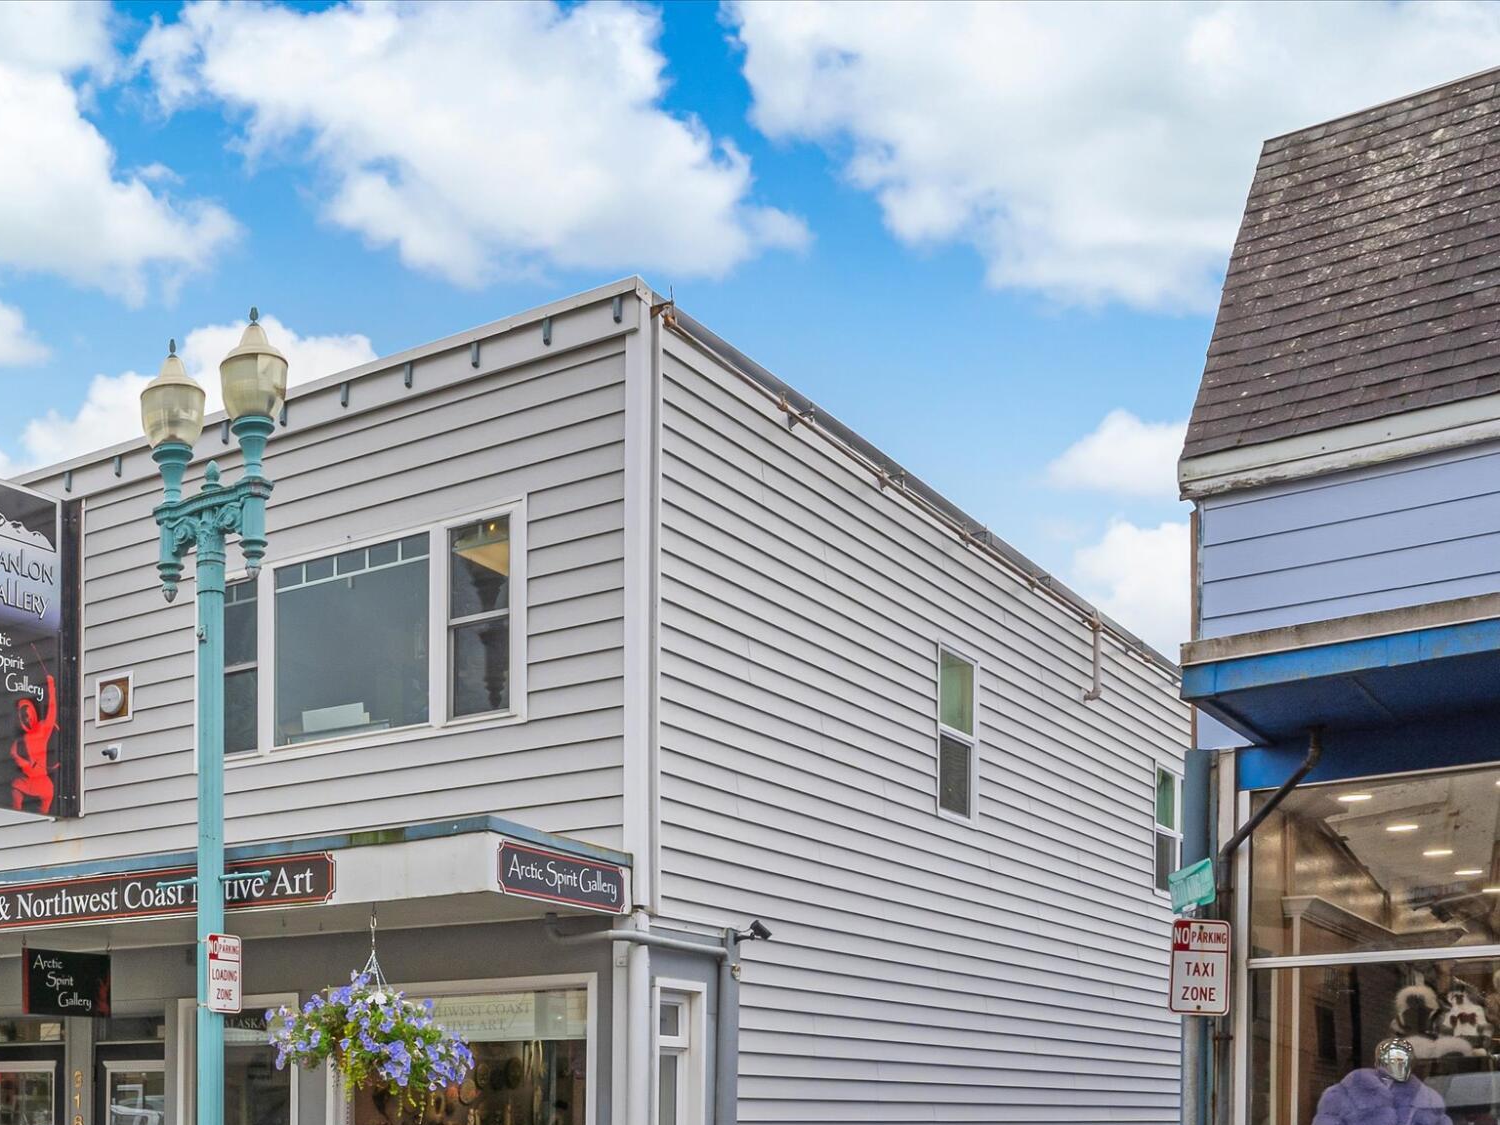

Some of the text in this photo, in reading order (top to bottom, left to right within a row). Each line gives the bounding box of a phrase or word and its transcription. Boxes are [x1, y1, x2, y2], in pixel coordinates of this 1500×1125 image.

[5, 673, 44, 702] Gallery
[508, 854, 617, 903] Arctic Spirit Gallery
[15, 887, 119, 921] Northwest
[124, 879, 184, 910] Coast
[191, 873, 265, 903] tive
[271, 867, 313, 897] Art
[1174, 927, 1227, 945] NO PARKING
[209, 940, 240, 955] NO PARKING
[33, 954, 63, 970] Arctic
[1185, 962, 1214, 977] TAXI
[45, 971, 74, 991] Spirit
[211, 968, 237, 982] LOADING
[58, 991, 92, 1011] Gallery
[216, 988, 233, 1001] ZONE
[1181, 987, 1216, 1002] ZONE
